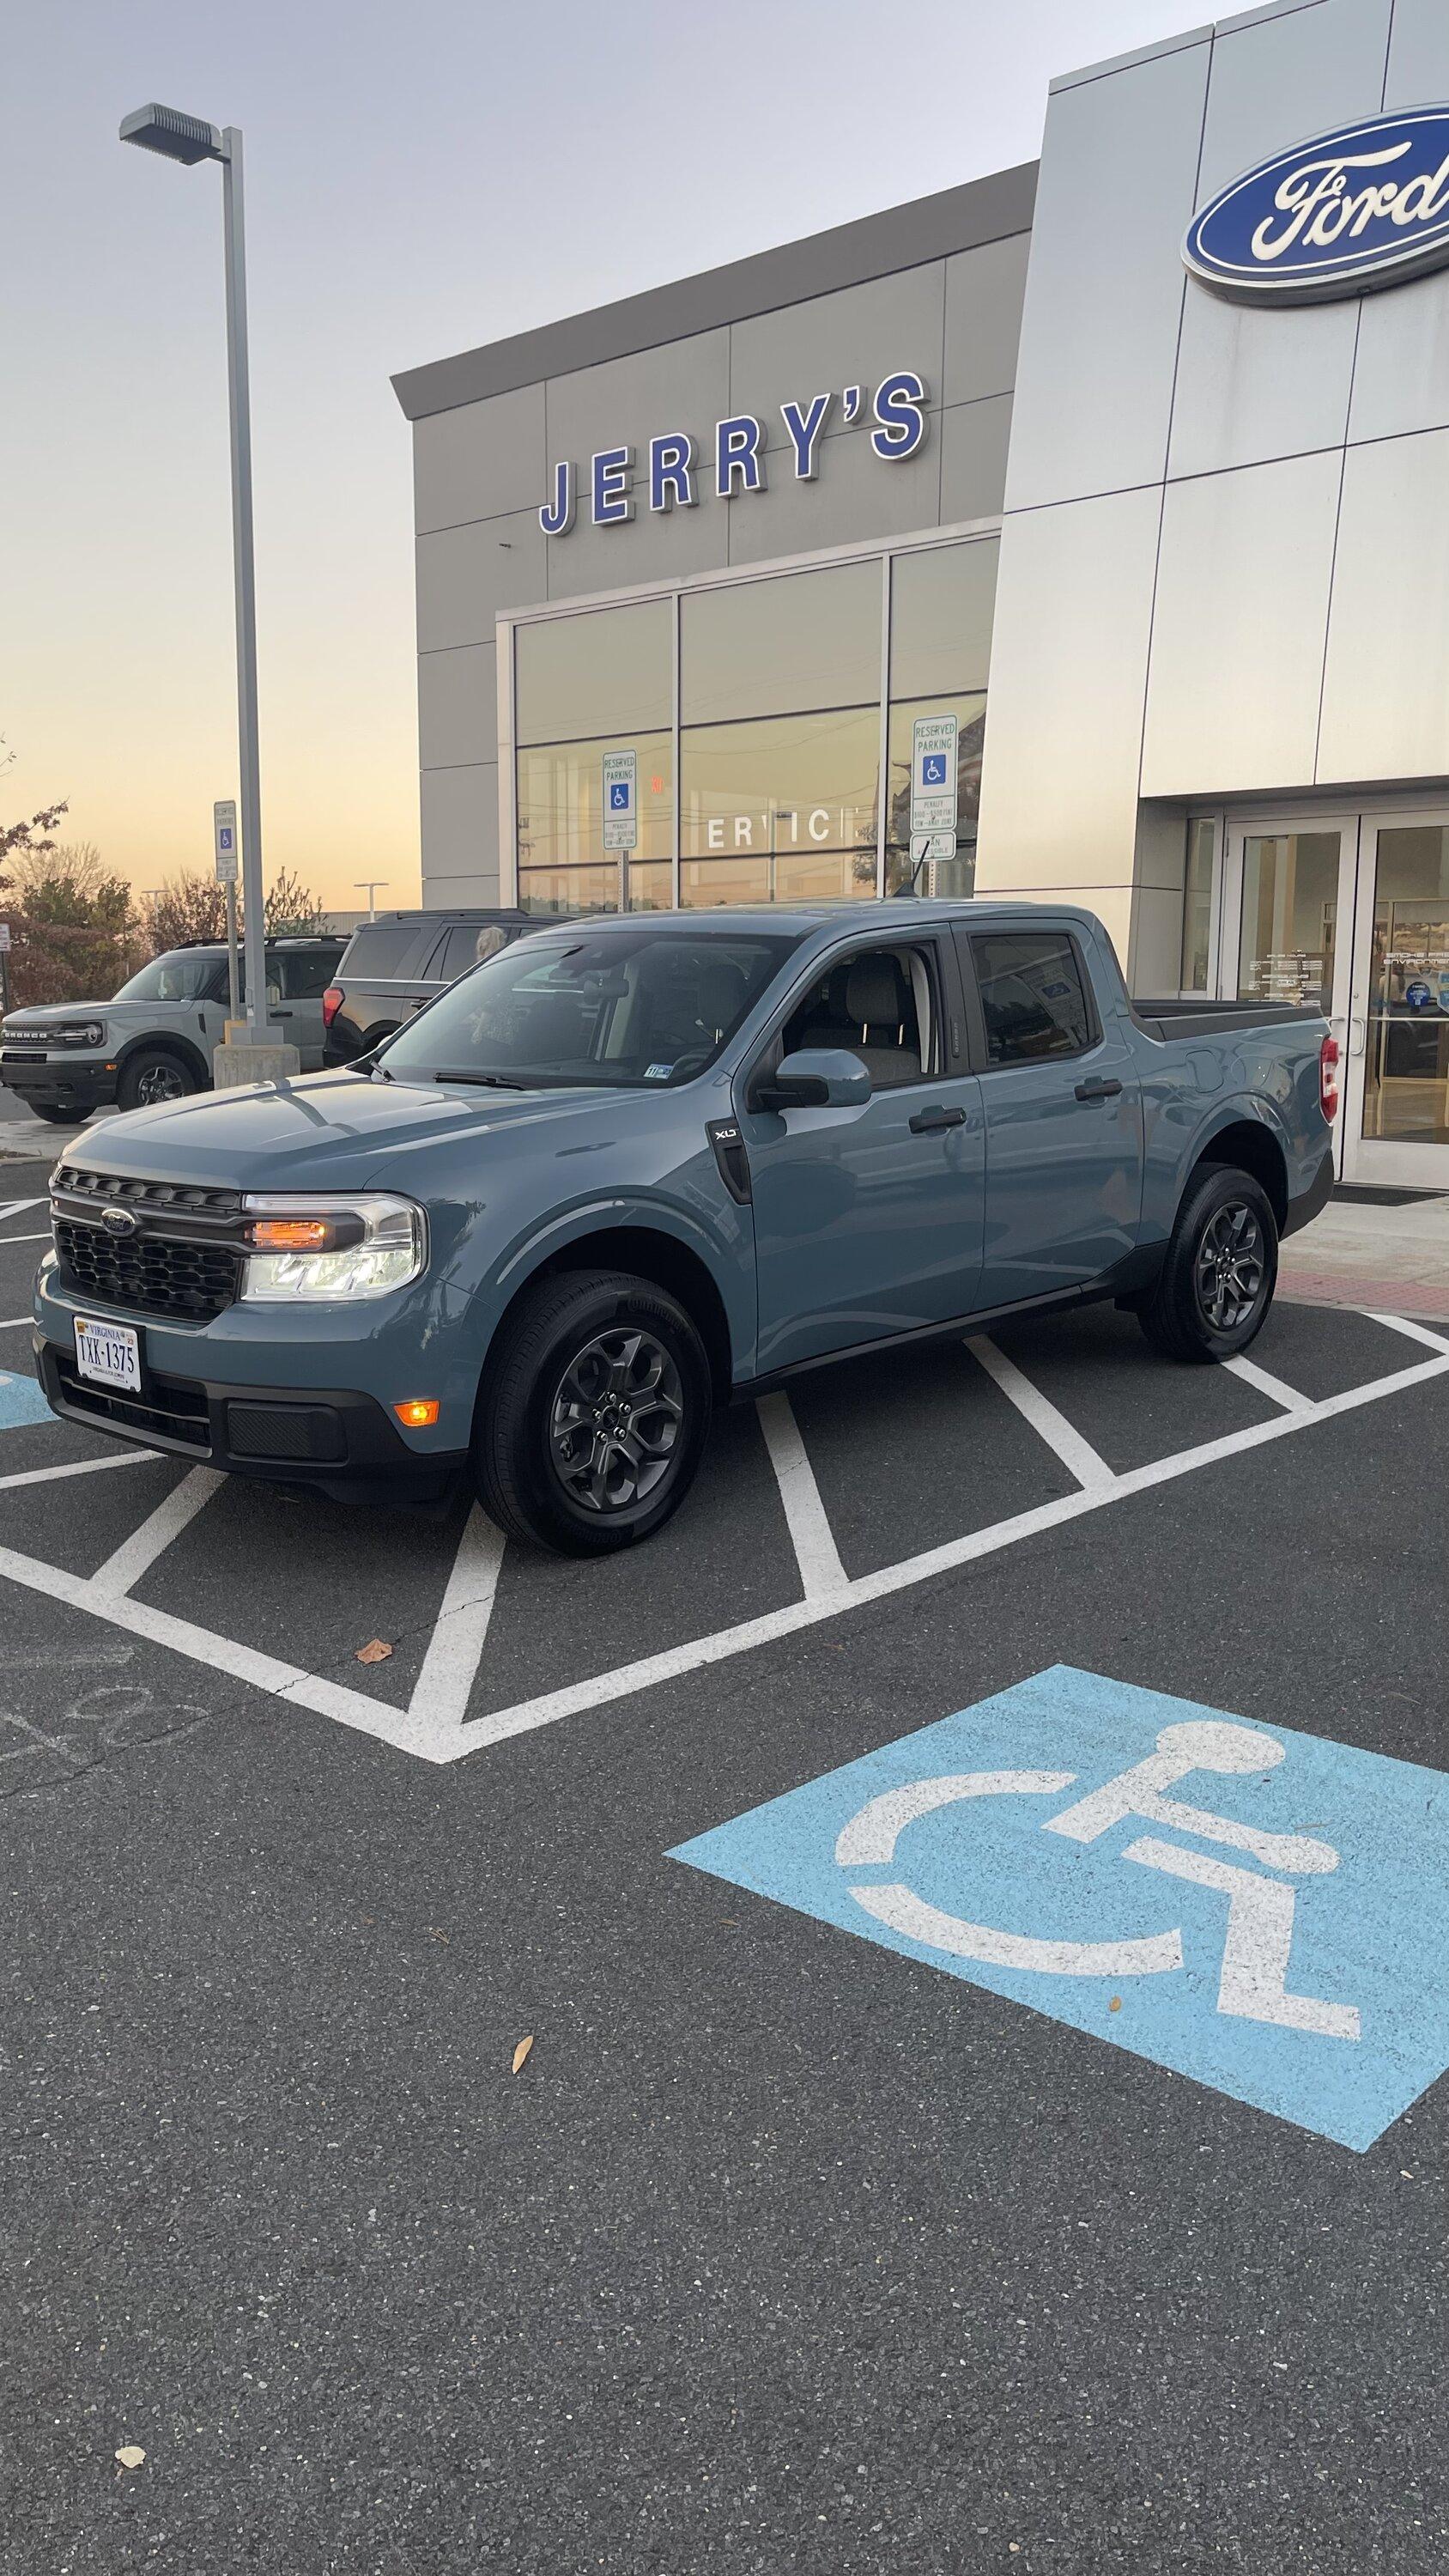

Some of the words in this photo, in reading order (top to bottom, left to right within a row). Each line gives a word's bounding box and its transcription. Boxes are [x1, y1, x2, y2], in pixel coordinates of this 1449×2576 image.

[1251, 141, 1449, 261] Ford
[539, 371, 931, 537] JERRY'S
[916, 723, 955, 738] RESERVED
[918, 738, 952, 752] PARKING
[604, 756, 635, 769] RESERVED
[606, 770, 633, 781] PARKING
[89, 1324, 121, 1340] VIRGINIA
[79, 1335, 135, 1373] TXK-1375
